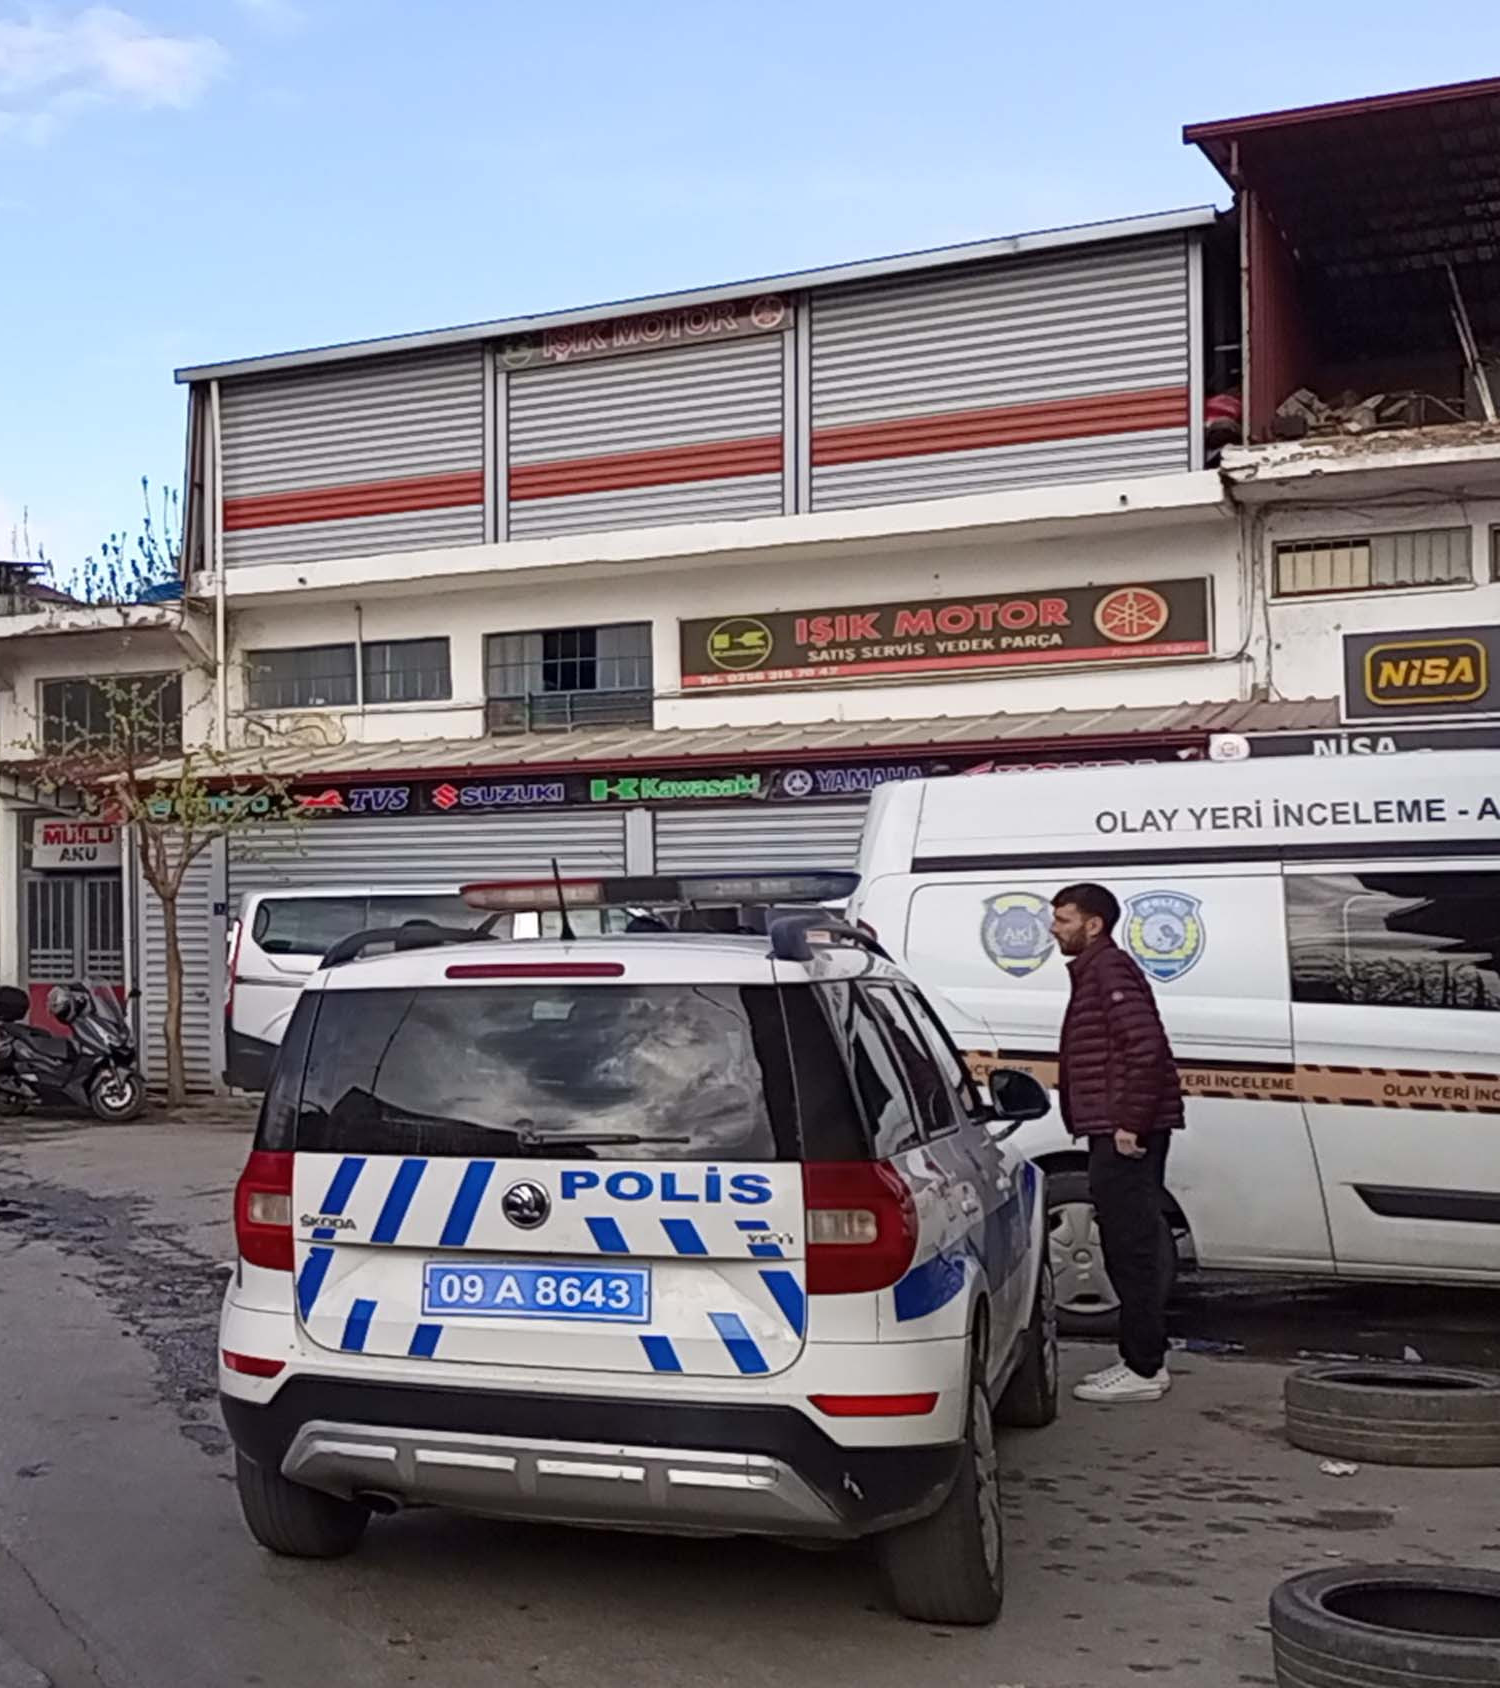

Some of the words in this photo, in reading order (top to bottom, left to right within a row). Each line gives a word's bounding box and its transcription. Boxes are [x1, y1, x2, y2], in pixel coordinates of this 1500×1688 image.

[613, 302, 739, 349] MOTOR
[794, 611, 882, 648] IŞIK
[893, 598, 1071, 637] MOTOR
[807, 648, 856, 663] SATIŞ
[861, 642, 925, 658] SERVİS
[935, 637, 996, 653] YEDEK
[1001, 633, 1063, 650] PARÇA
[350, 788, 410, 811] TVS
[460, 783, 565, 806] SUZUKI
[641, 773, 761, 798] Kawasaki
[1096, 808, 1179, 834] OLAY
[1188, 799, 1263, 831] YERİ
[1272, 798, 1447, 829] İNCELEME
[1214, 1074, 1294, 1091] İNCELEME
[1383, 1083, 1427, 1098] OLAY
[1431, 1084, 1470, 1100] YERİ
[561, 1166, 773, 1205] POLİS
[440, 1274, 485, 1304] 09
[494, 1275, 525, 1305] A
[535, 1276, 631, 1310] 8643
